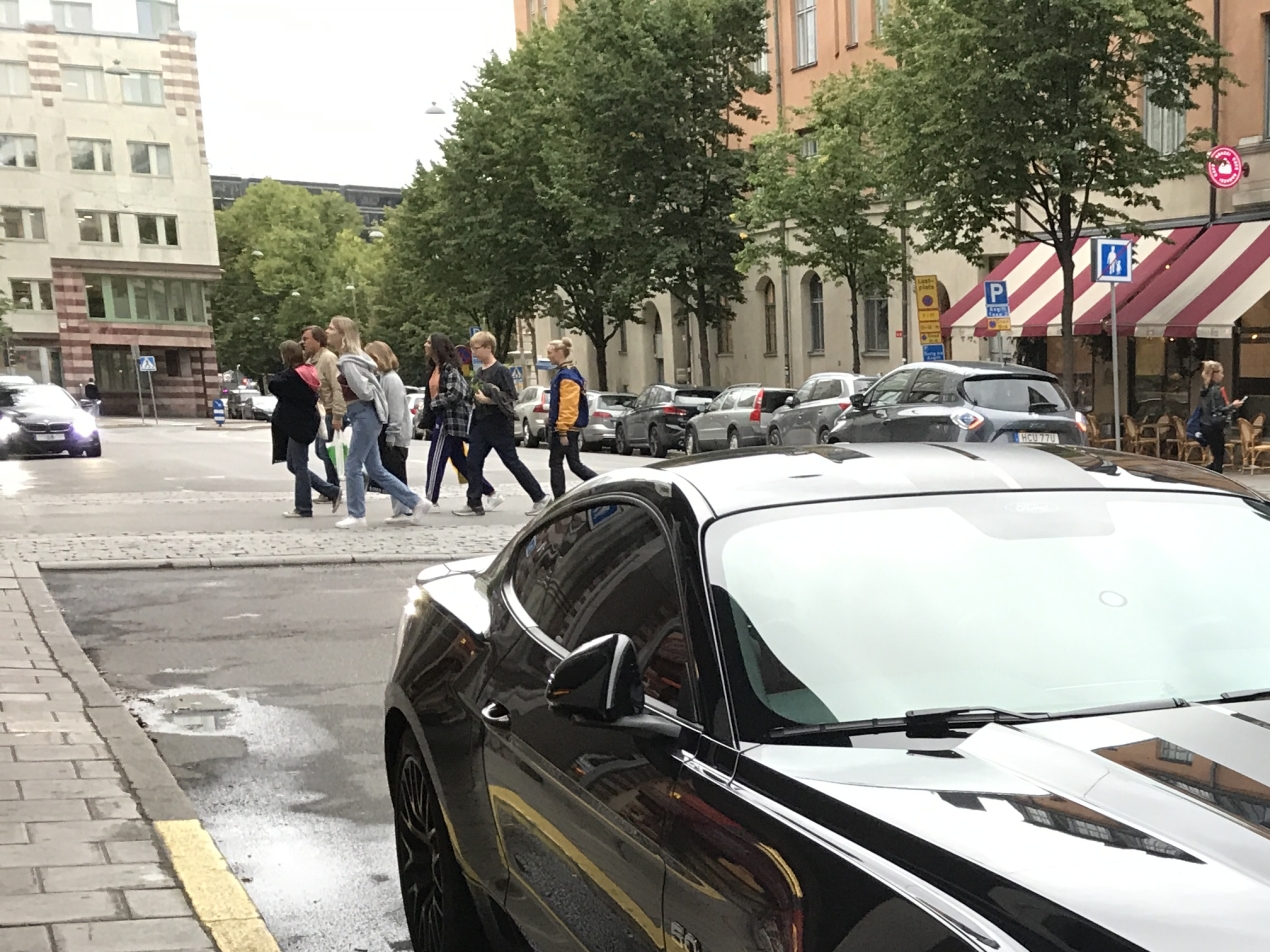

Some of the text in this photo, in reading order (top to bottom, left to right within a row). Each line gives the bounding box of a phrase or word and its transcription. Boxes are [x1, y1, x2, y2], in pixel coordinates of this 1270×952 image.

[990, 283, 1003, 303] P
[1021, 433, 1038, 442] HCU
[1039, 433, 1056, 443] 77U
